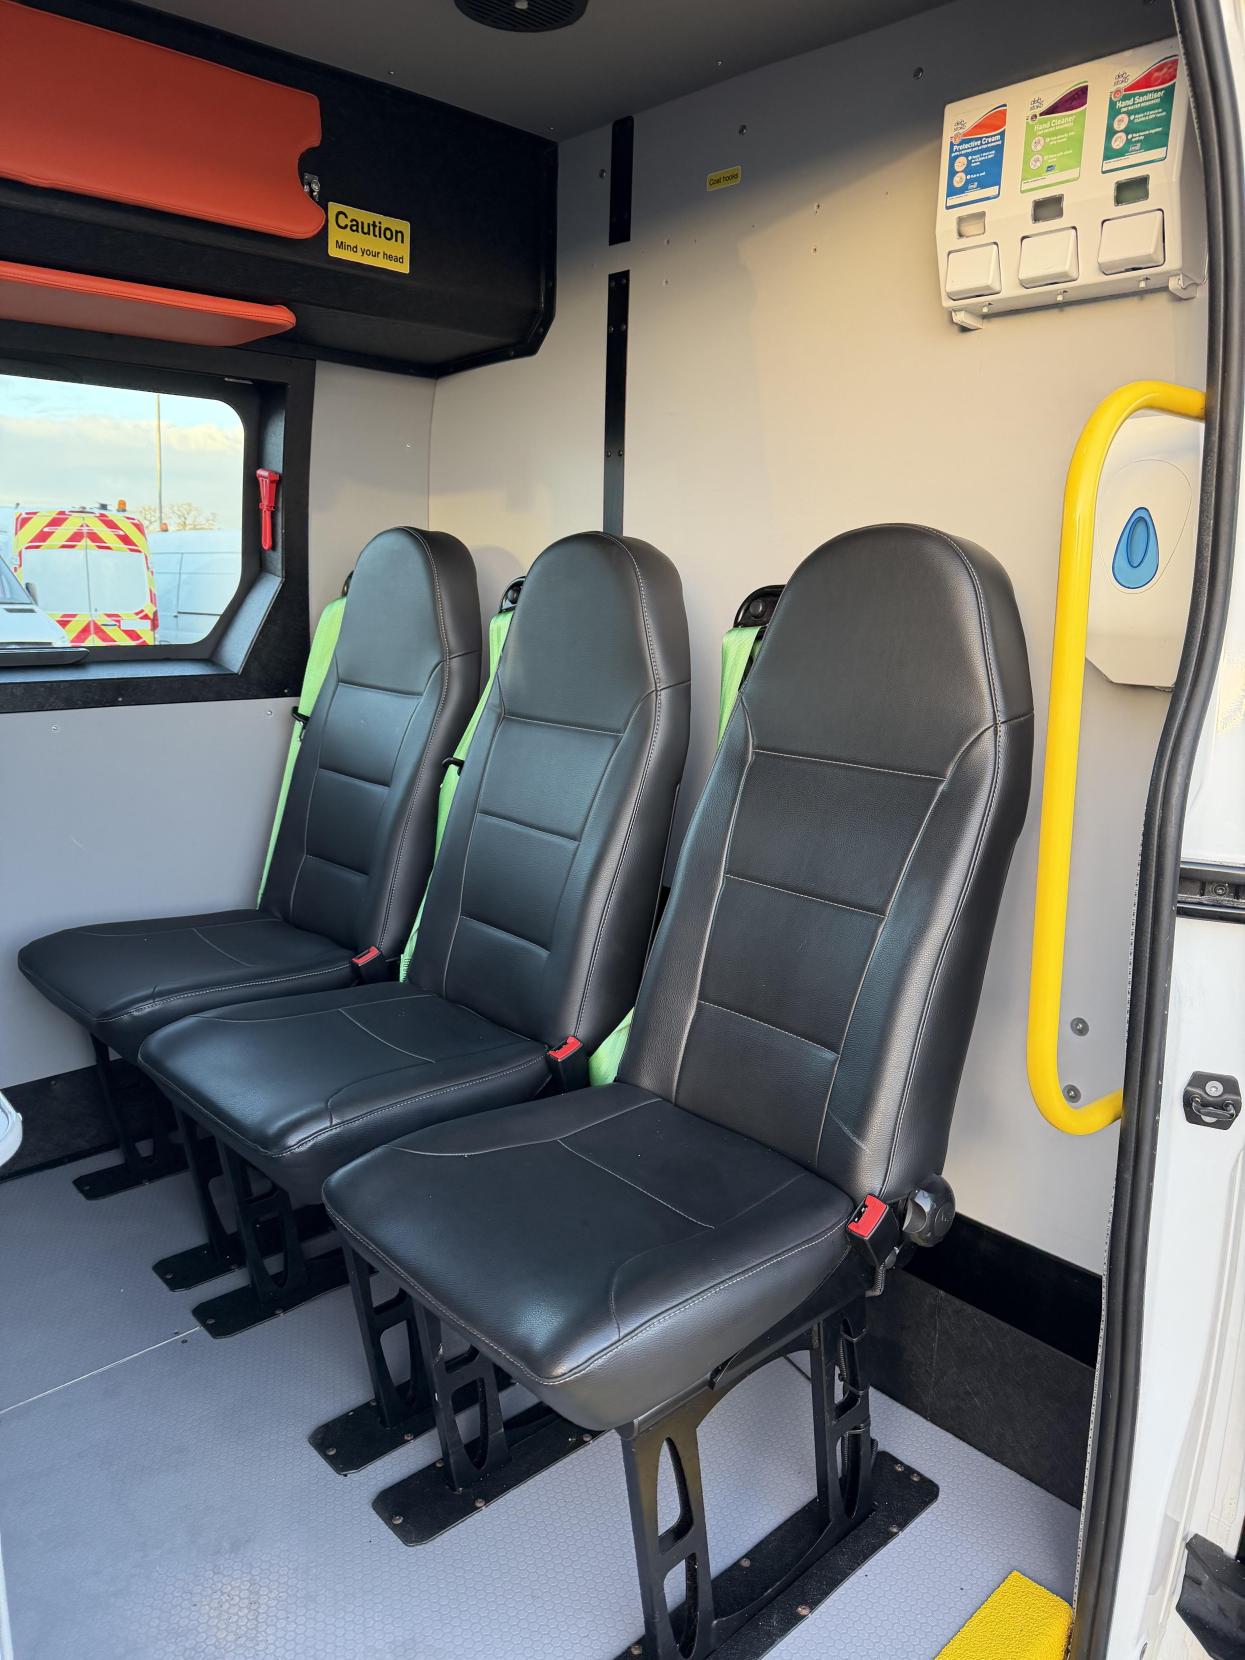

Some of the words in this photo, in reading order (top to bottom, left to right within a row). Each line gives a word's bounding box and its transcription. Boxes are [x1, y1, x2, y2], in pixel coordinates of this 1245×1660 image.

[1116, 97, 1134, 109] Hand
[1134, 90, 1165, 104] Sanitiser
[1034, 120, 1050, 131] Hand
[1050, 115, 1076, 127] Cleaner
[953, 140, 981, 151] Protective
[981, 135, 1001, 145] Cream
[335, 210, 405, 244] Caution
[335, 240, 358, 253] Mind
[360, 247, 381, 257] your
[382, 251, 404, 264] head
